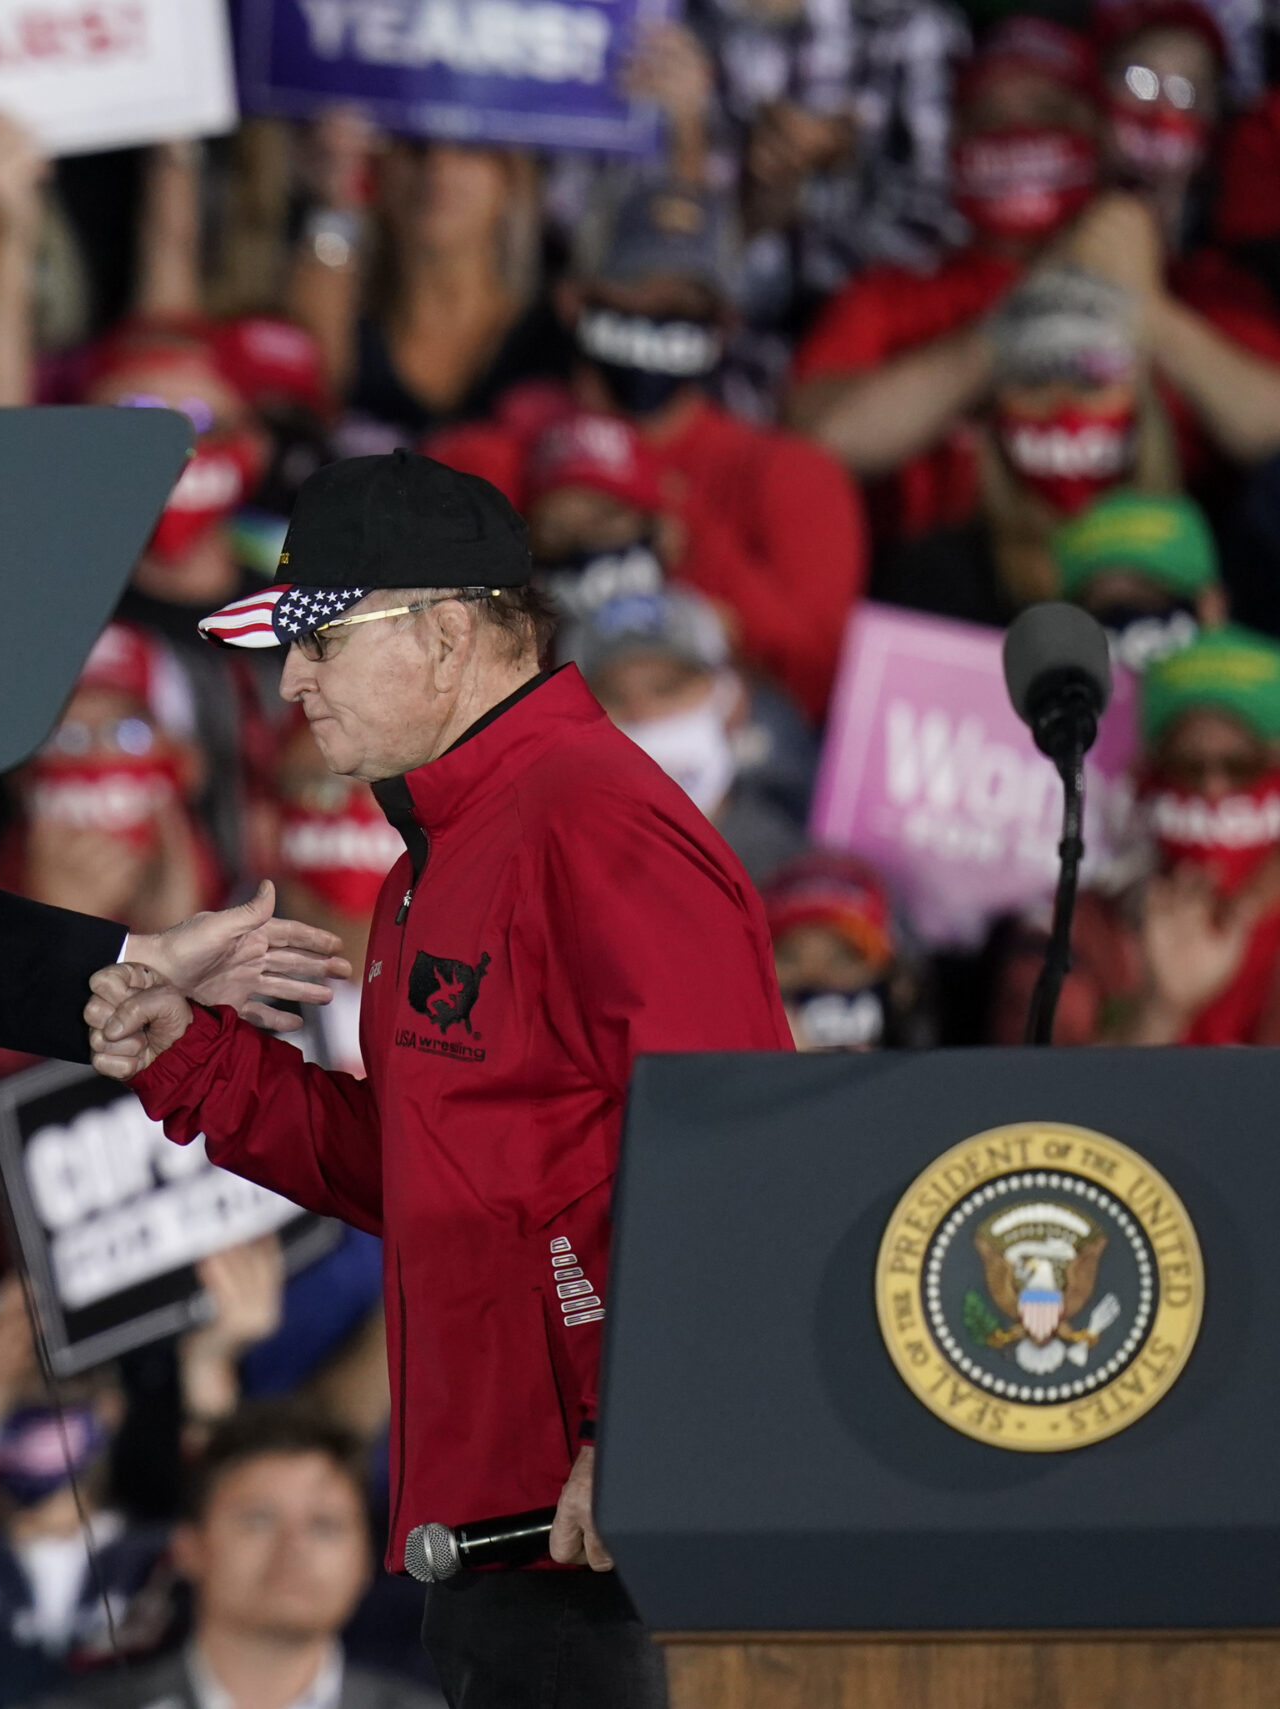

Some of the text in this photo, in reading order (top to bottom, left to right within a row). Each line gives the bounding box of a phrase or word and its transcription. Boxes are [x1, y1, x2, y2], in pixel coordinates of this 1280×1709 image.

[394, 1027, 417, 1049] USA
[1043, 1140, 1076, 1161] OF
[1080, 1147, 1121, 1179] THE
[889, 1137, 1033, 1276] PRESIDENT
[1125, 1175, 1194, 1310] UNITED
[892, 1288, 917, 1333] THE
[927, 1359, 1009, 1431] SEAL
[1066, 1335, 1178, 1434] STATES
